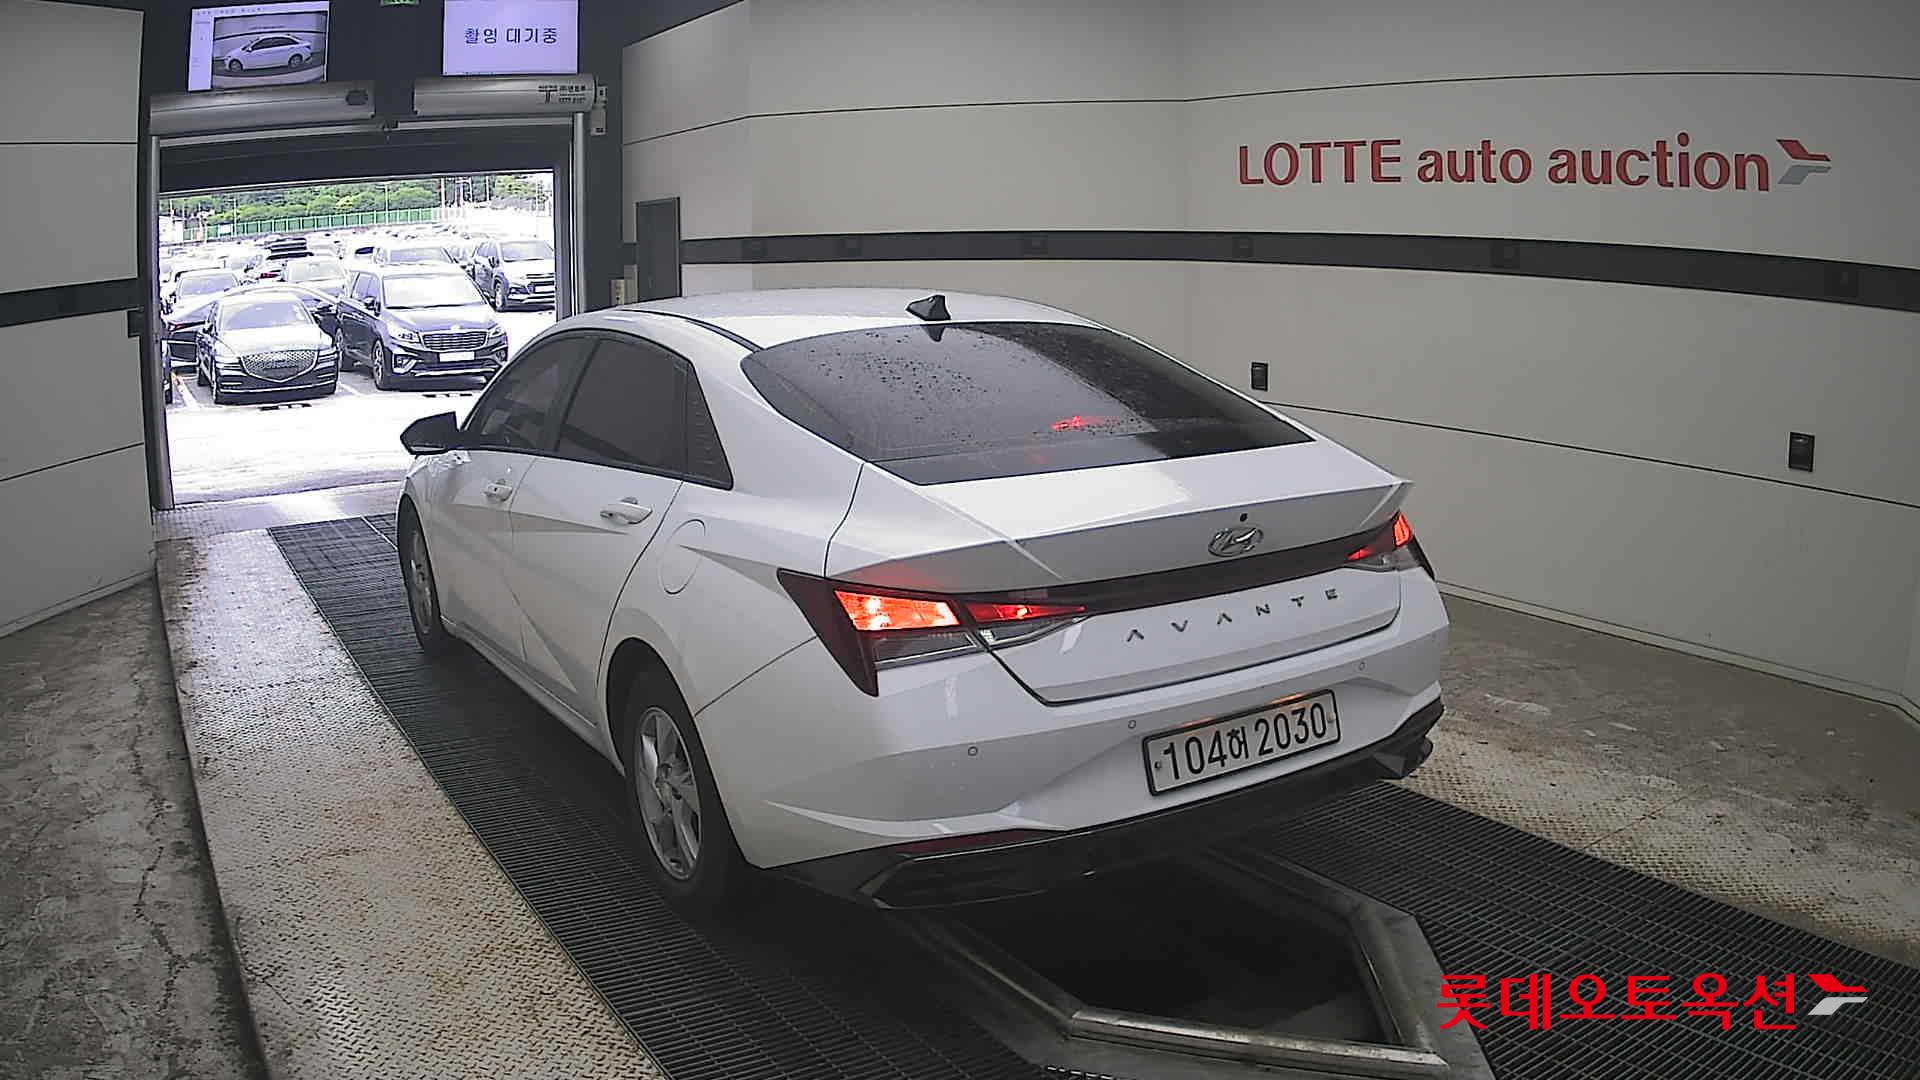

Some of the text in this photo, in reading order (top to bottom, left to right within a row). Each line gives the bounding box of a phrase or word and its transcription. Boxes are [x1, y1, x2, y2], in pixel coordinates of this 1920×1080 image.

[464, 27, 558, 44] 촬영 대기중
[1238, 131, 1770, 192] LOTTE auto auction
[1126, 588, 1339, 642] AVANTE
